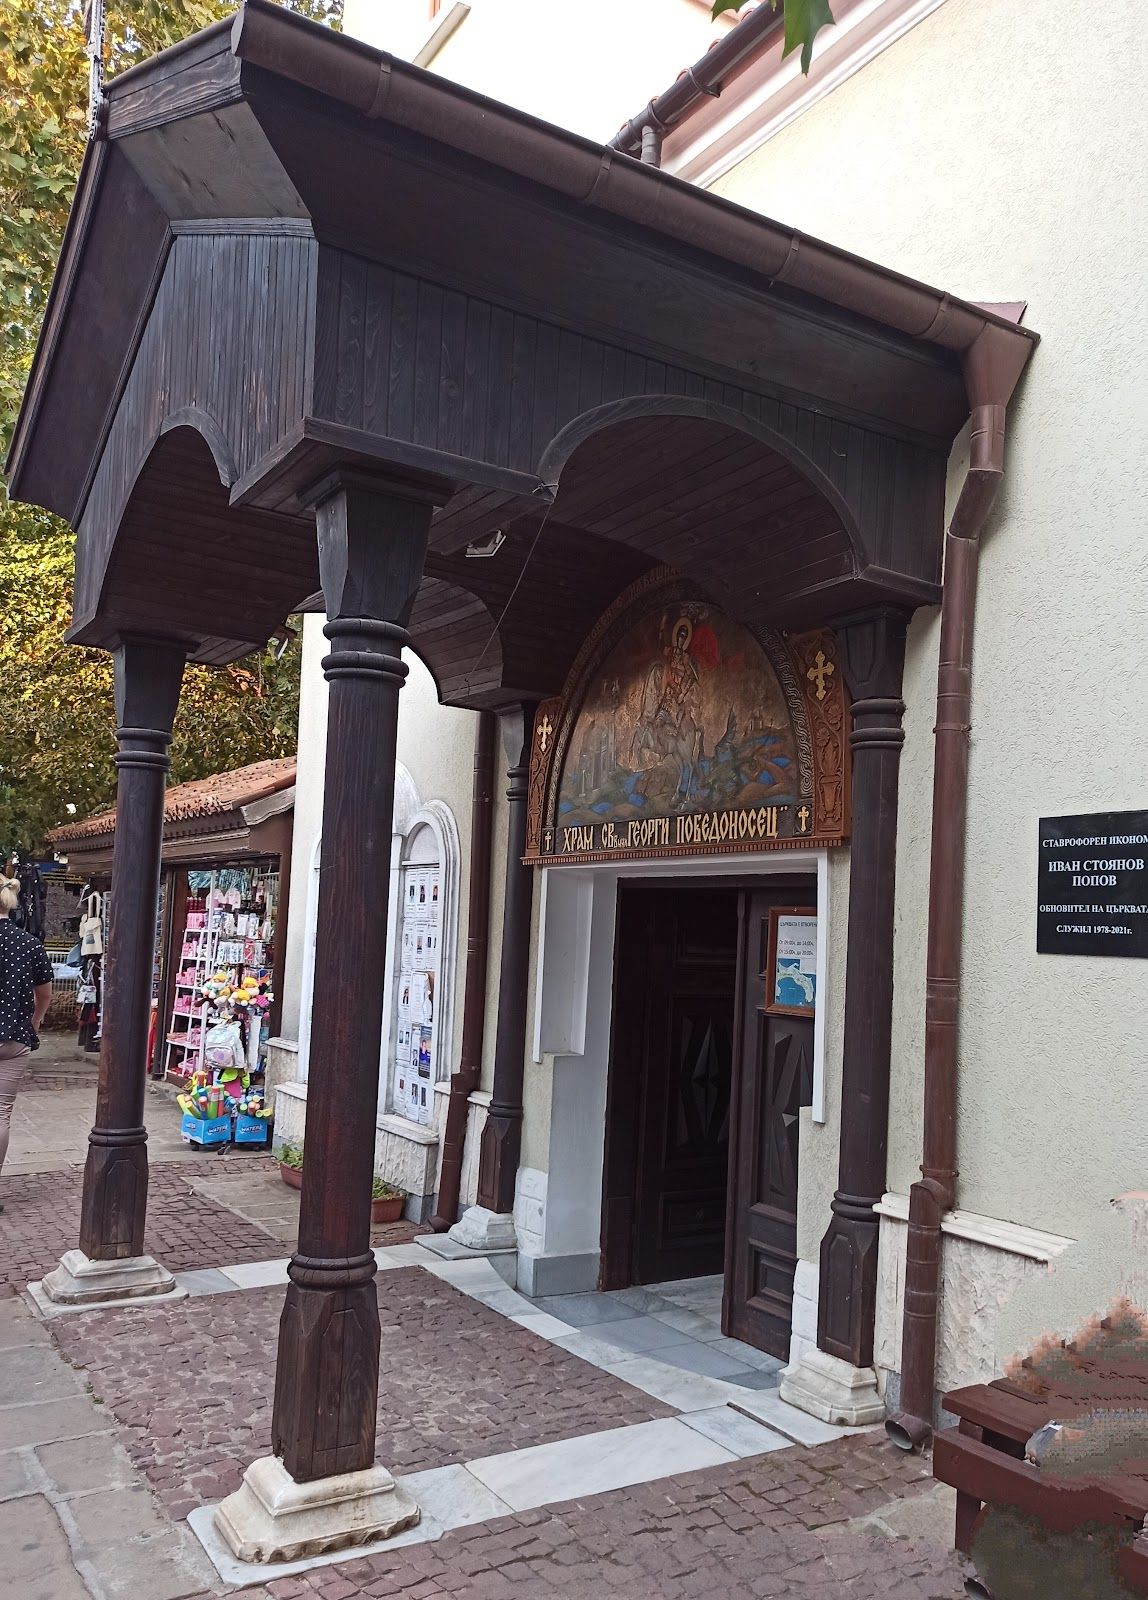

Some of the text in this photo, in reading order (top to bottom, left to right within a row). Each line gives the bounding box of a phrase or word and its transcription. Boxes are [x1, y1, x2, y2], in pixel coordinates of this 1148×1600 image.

[561, 826, 594, 853] ХРАМ
[627, 817, 670, 847] ГЕОРГИ
[1042, 837, 1107, 848] СТАВРОФОРЕН
[1048, 859, 1145, 872] ИВАН СТОЯНОВ
[1072, 875, 1117, 887] ПОПОВ
[1039, 904, 1090, 913] ОБНОВИТЕЛ
[1092, 905, 1104, 913] НА
[1056, 924, 1133, 935] СЛУЖИЛ 1978-2021г.
